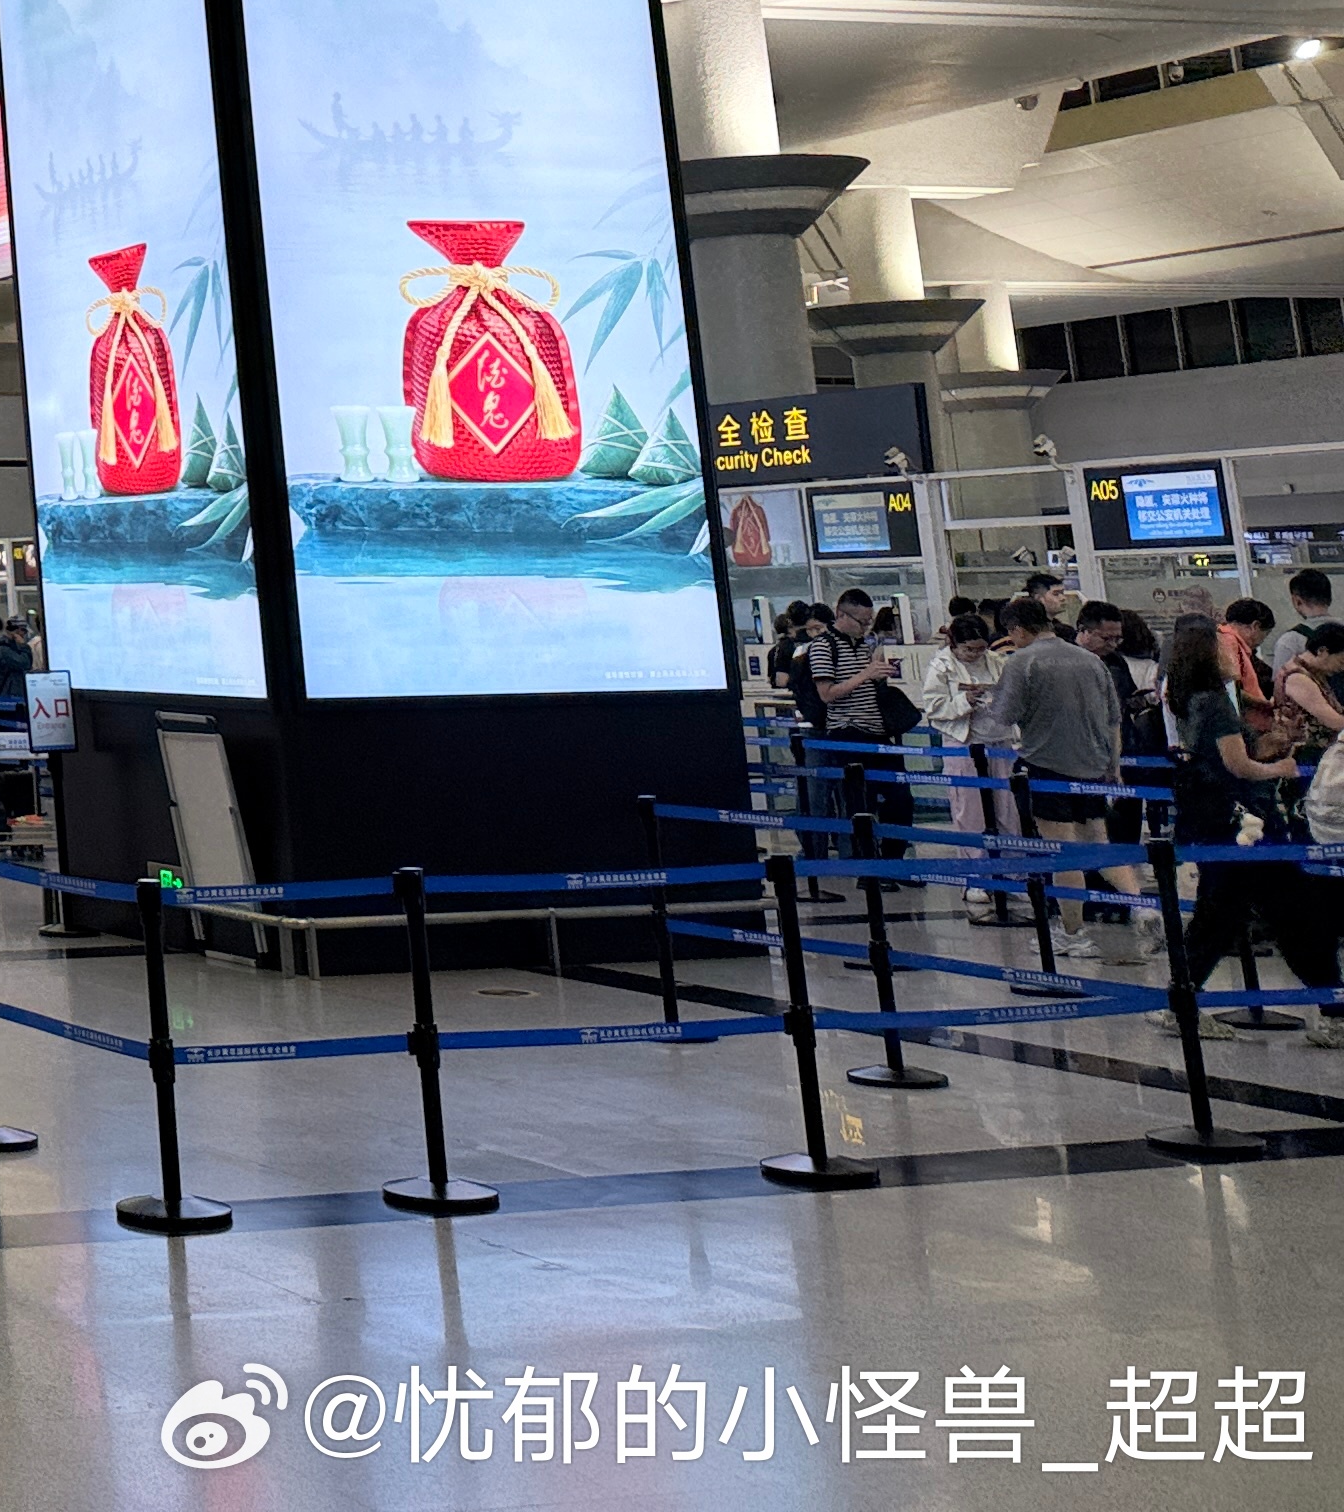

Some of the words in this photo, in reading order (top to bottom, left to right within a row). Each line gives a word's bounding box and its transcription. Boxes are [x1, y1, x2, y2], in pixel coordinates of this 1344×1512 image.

[717, 406, 810, 447] 全检查
[715, 450, 759, 473] curity
[761, 445, 812, 467] Check
[1090, 479, 1119, 501] A05
[888, 493, 912, 513] A04
[32, 697, 70, 719] 入口
